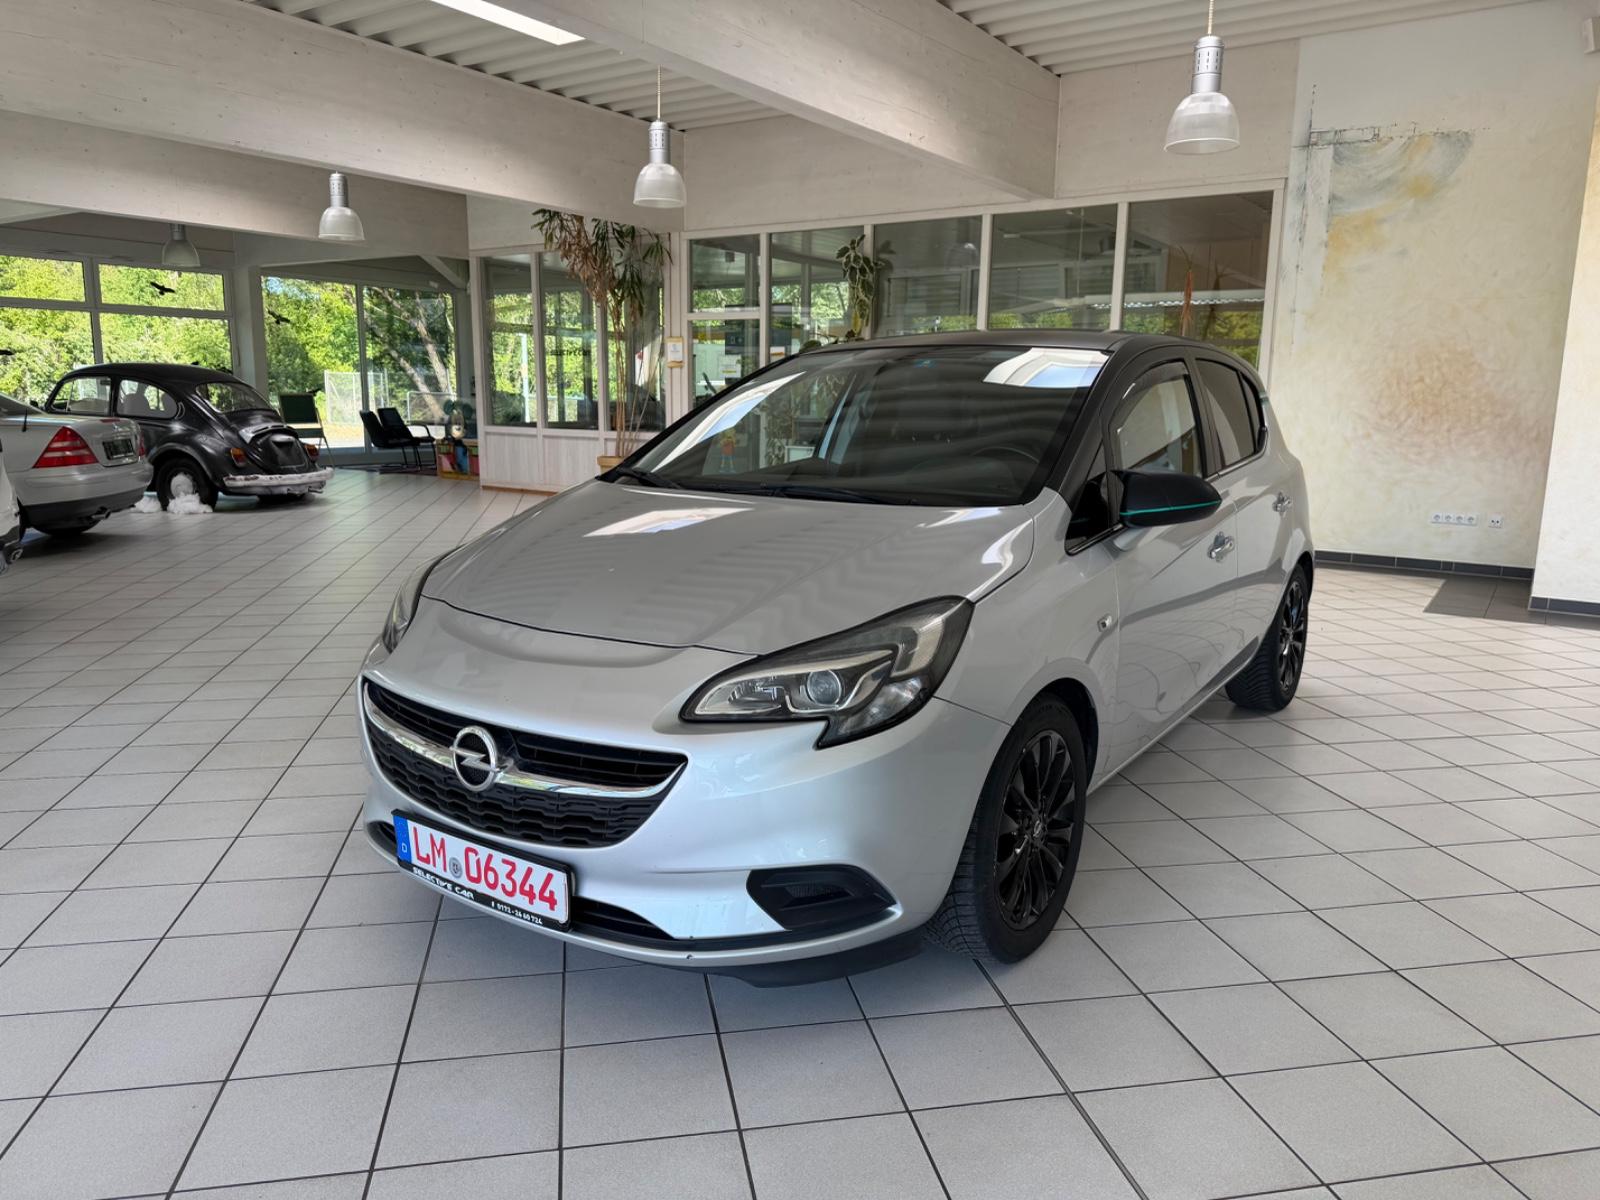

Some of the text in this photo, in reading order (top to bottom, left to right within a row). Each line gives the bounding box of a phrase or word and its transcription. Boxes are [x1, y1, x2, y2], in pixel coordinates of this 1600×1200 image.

[401, 842, 408, 853] D
[413, 826, 558, 912] LM 06344
[454, 886, 475, 901] CAR
